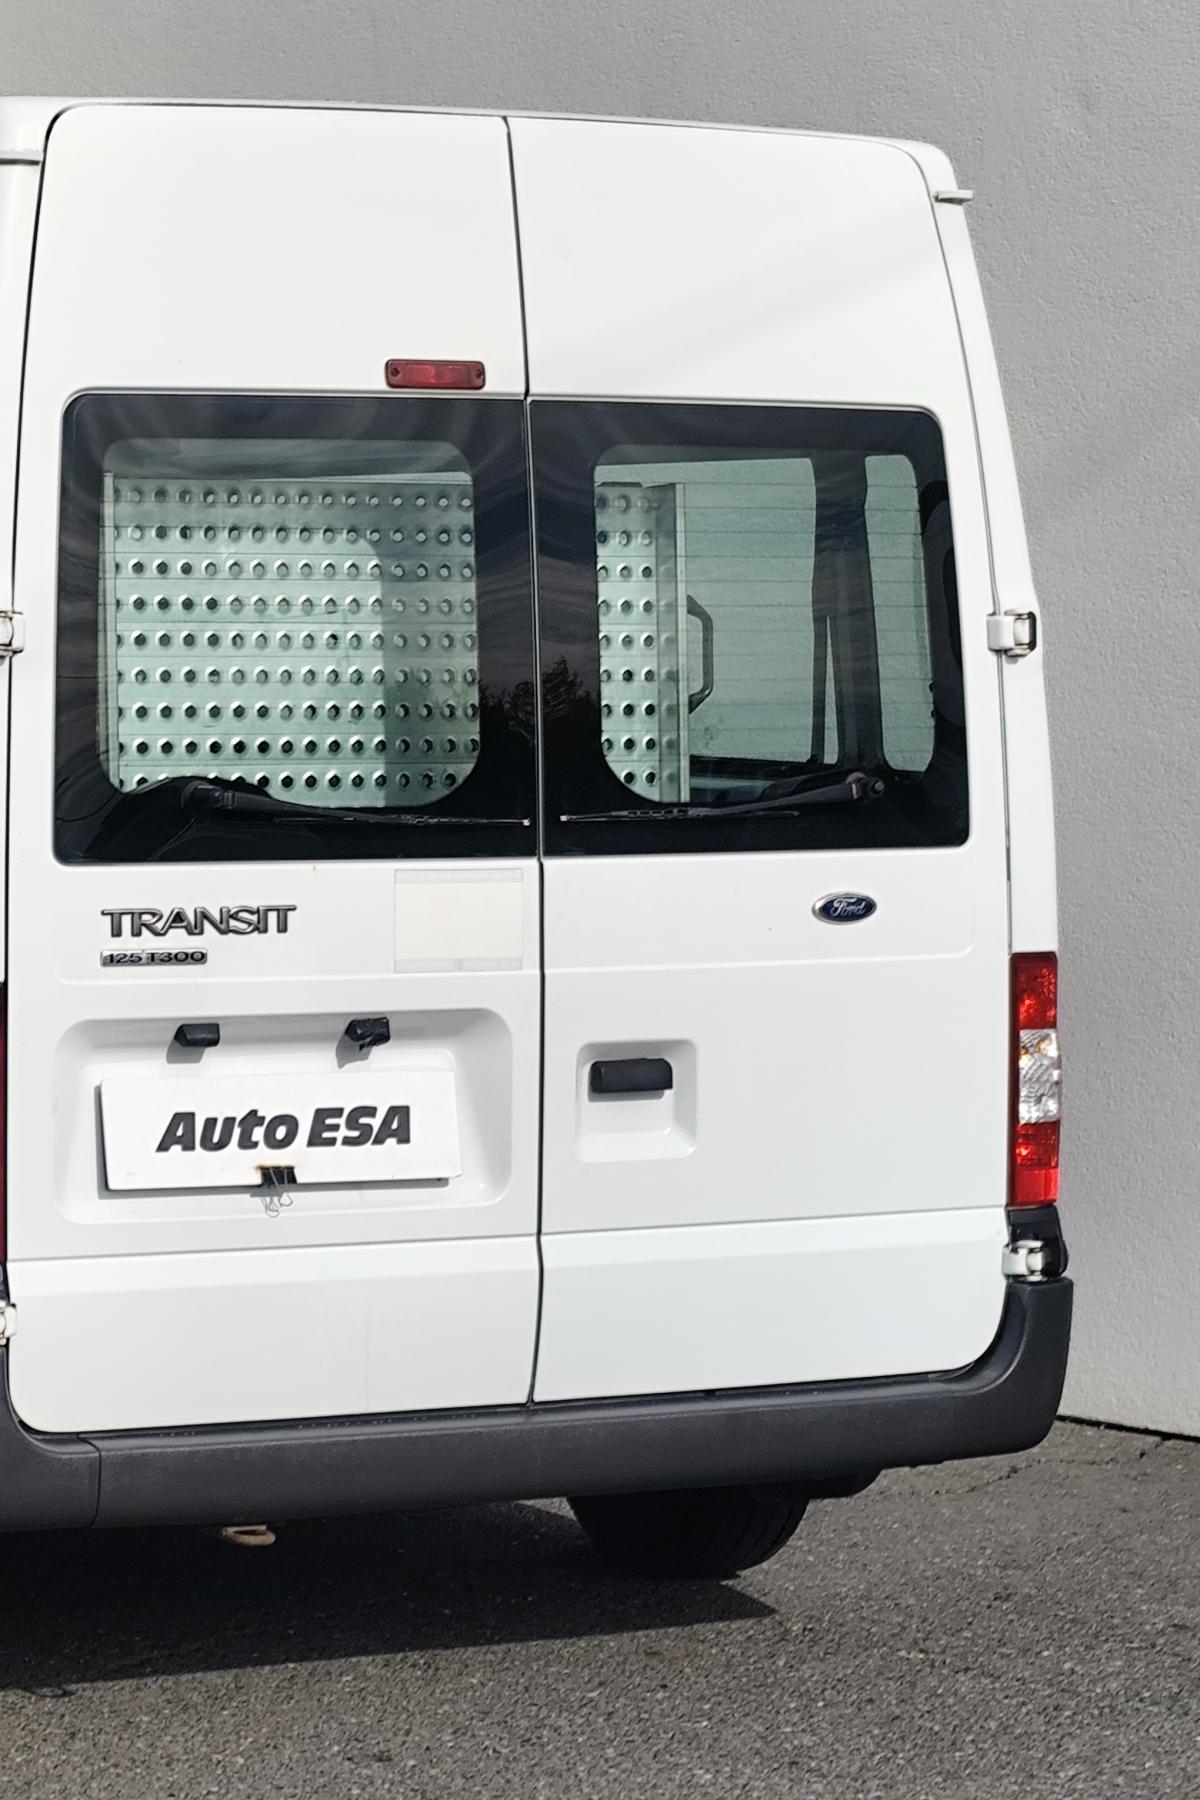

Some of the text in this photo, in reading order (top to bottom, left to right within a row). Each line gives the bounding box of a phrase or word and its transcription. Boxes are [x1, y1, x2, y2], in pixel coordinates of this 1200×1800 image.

[102, 905, 297, 937] TRANSIT
[831, 897, 866, 917] Ford
[156, 1105, 411, 1152] Auto ESA
